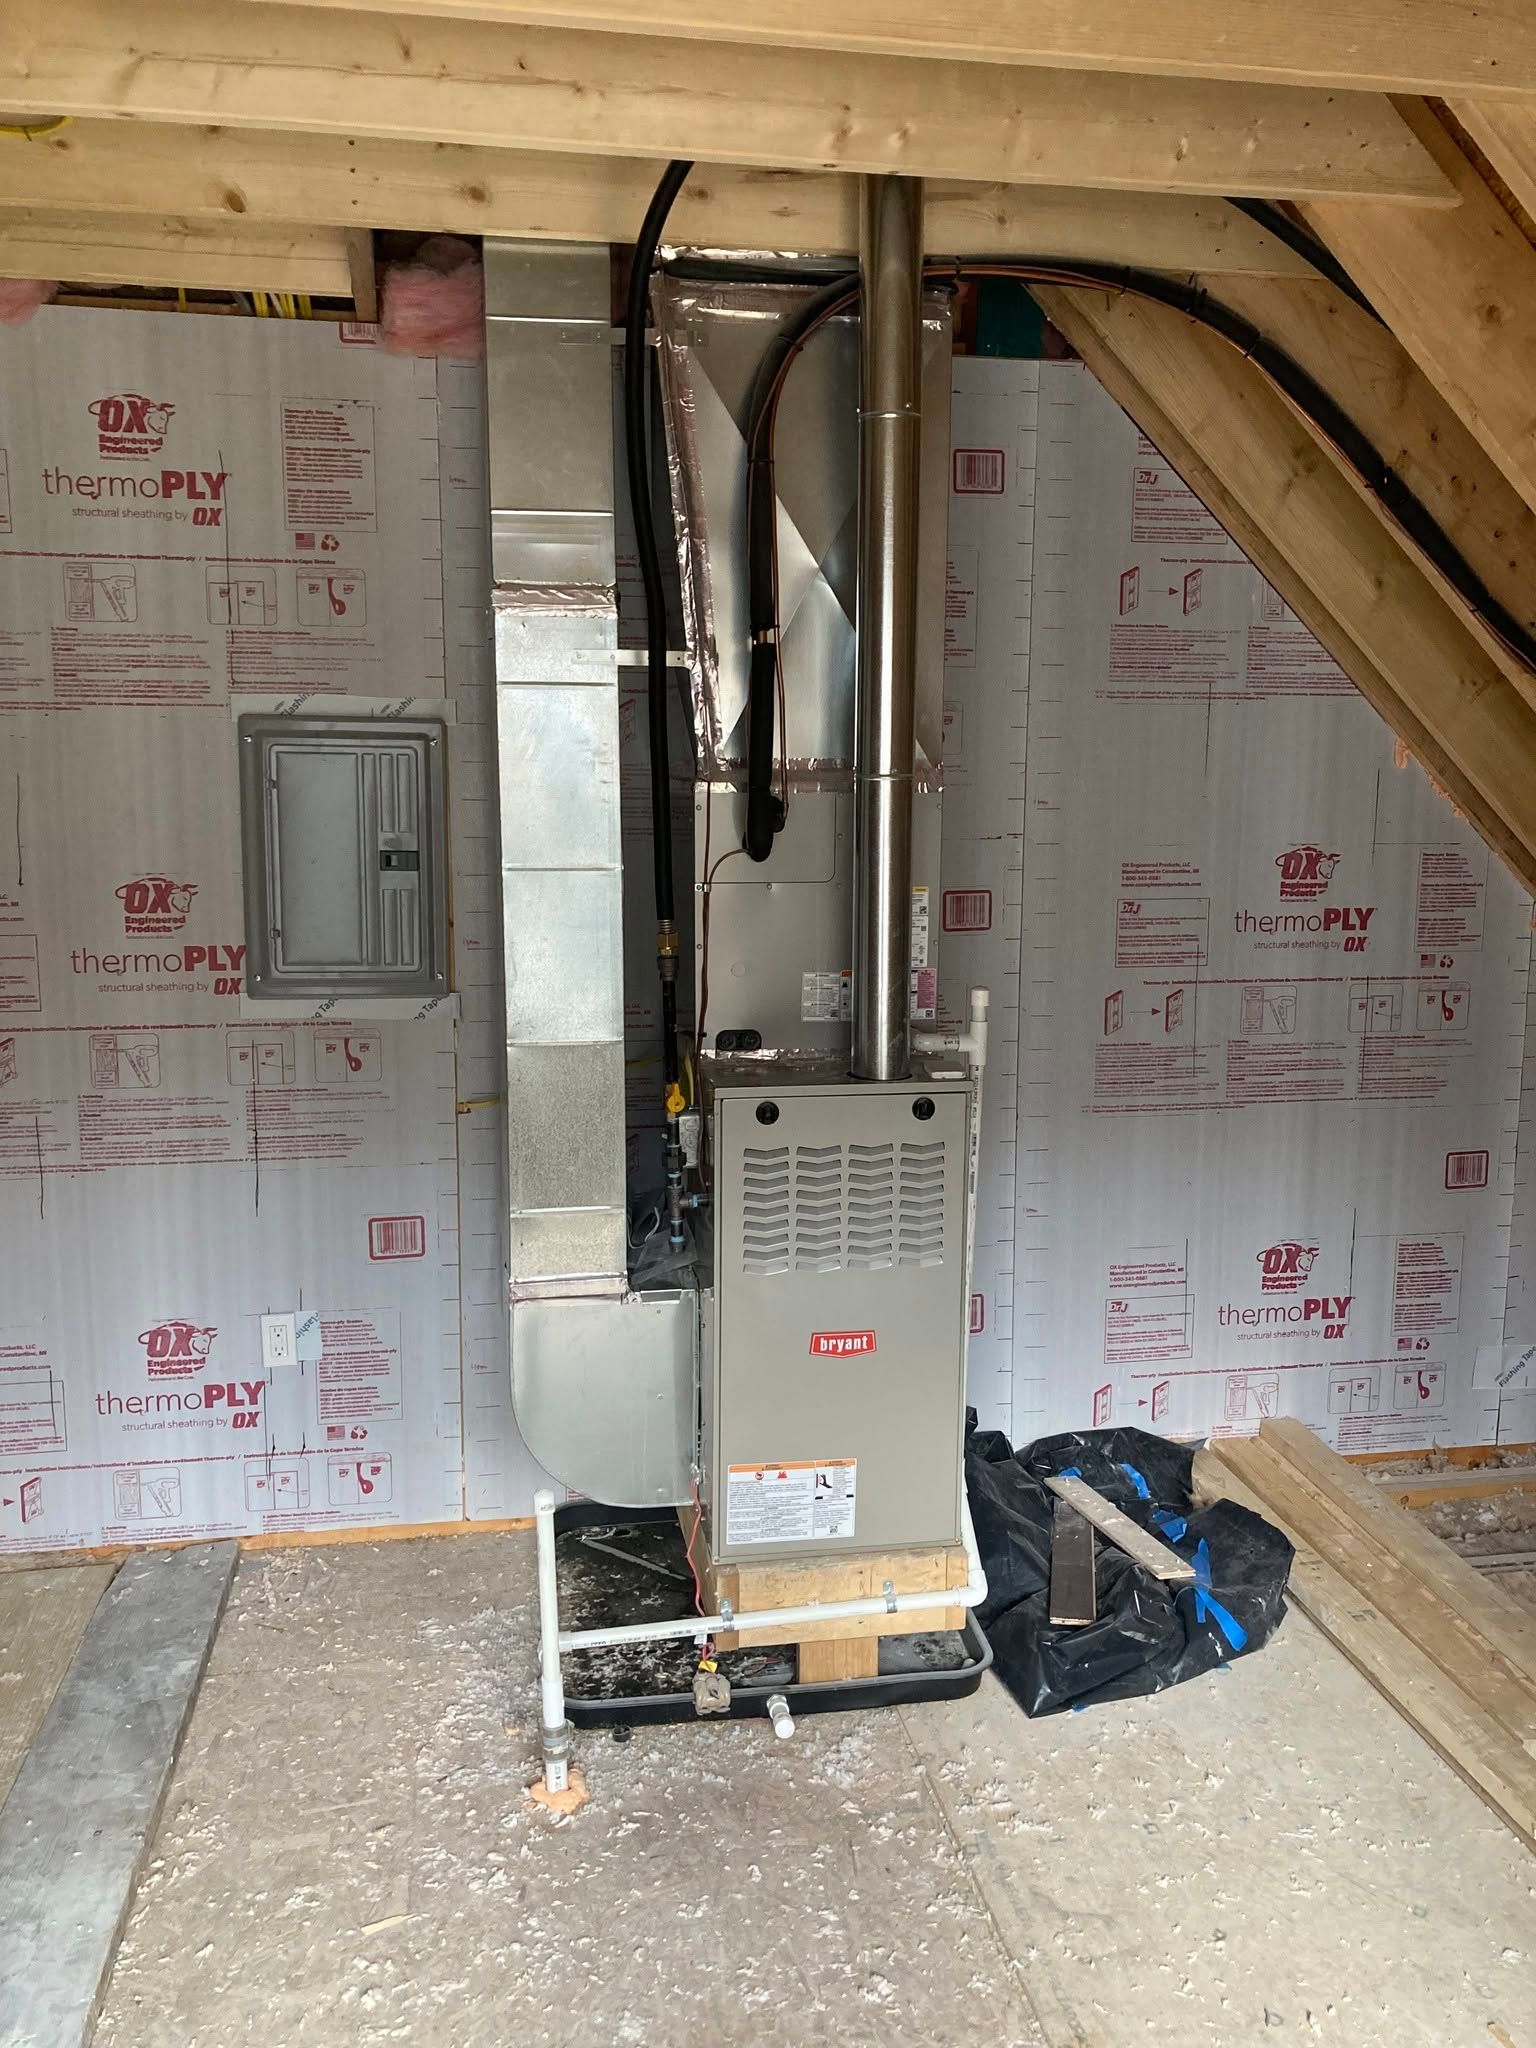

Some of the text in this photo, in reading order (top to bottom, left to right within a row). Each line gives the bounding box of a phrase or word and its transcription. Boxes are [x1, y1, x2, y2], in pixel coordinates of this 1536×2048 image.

[98, 399, 149, 434] OX
[99, 434, 163, 446] Engineered
[99, 444, 149, 454] Products
[42, 466, 228, 501] thermoPLY
[72, 507, 223, 527] structural sheathing by OX
[1281, 853, 1321, 880] OX
[1280, 881, 1328, 890] Engineered
[124, 883, 172, 914] OX
[124, 915, 186, 926] Engineered
[125, 925, 172, 933] Products
[1234, 908, 1375, 935] thermoPLY
[1254, 936, 1368, 952] structural sheathing by OX
[70, 944, 247, 977] thermoPLY
[98, 977, 243, 995] structural sheathing by OX
[318, 998, 339, 1012] Tap
[421, 997, 442, 1012] Tap
[1262, 1247, 1301, 1274] OX
[1262, 1273, 1308, 1283] Engineered
[1262, 1282, 1297, 1290] Products
[1218, 1296, 1352, 1327] thermoPLY
[1237, 1323, 1346, 1341] structural sheathing by OX
[147, 1326, 194, 1357] OX
[819, 1335, 868, 1353] bryant
[147, 1357, 206, 1369] Engineered
[147, 1365, 193, 1376] Products
[1499, 1361, 1526, 1388] Flashing
[95, 1380, 266, 1416] thermoPLY
[122, 1411, 260, 1431] structural sheathing by OX
